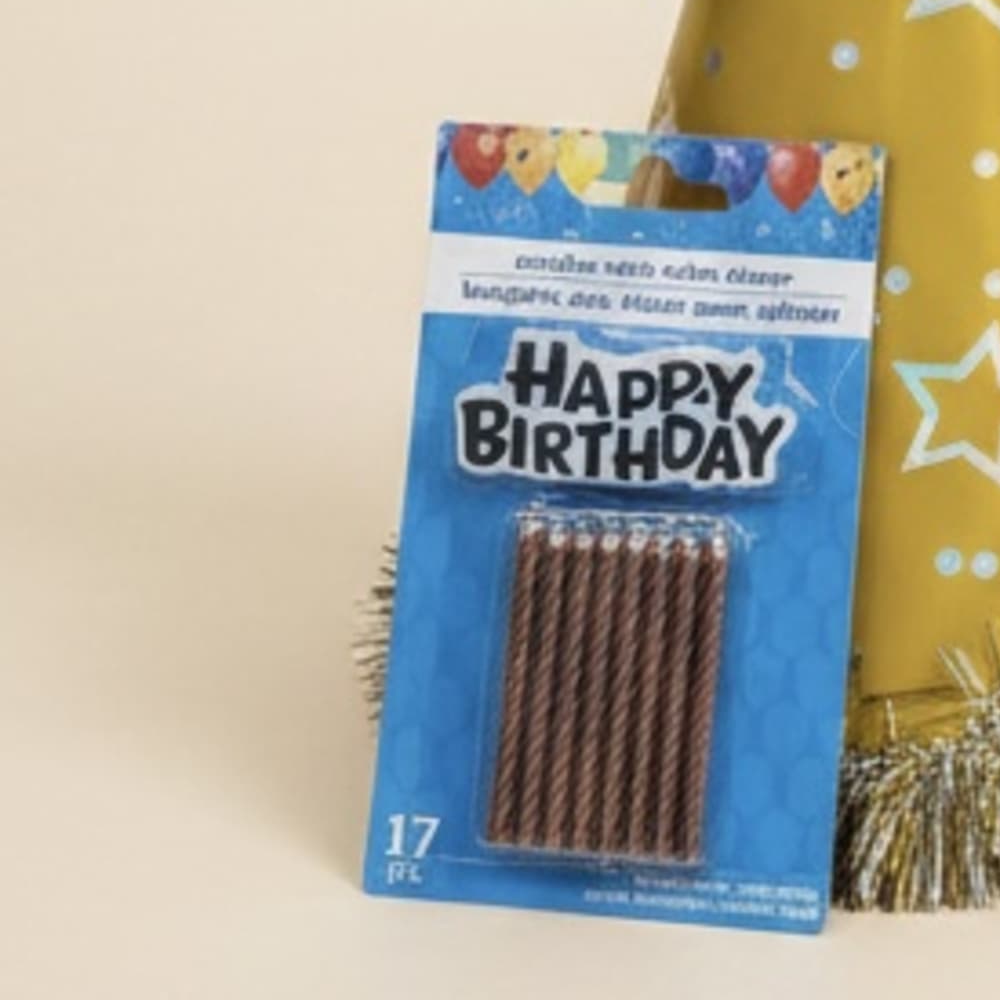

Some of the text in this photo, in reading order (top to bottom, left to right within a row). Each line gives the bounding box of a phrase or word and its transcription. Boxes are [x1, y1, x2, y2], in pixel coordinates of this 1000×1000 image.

[505, 341, 754, 421] HAPPY
[461, 398, 785, 482] BIRTHDAY
[384, 813, 441, 859] 17
